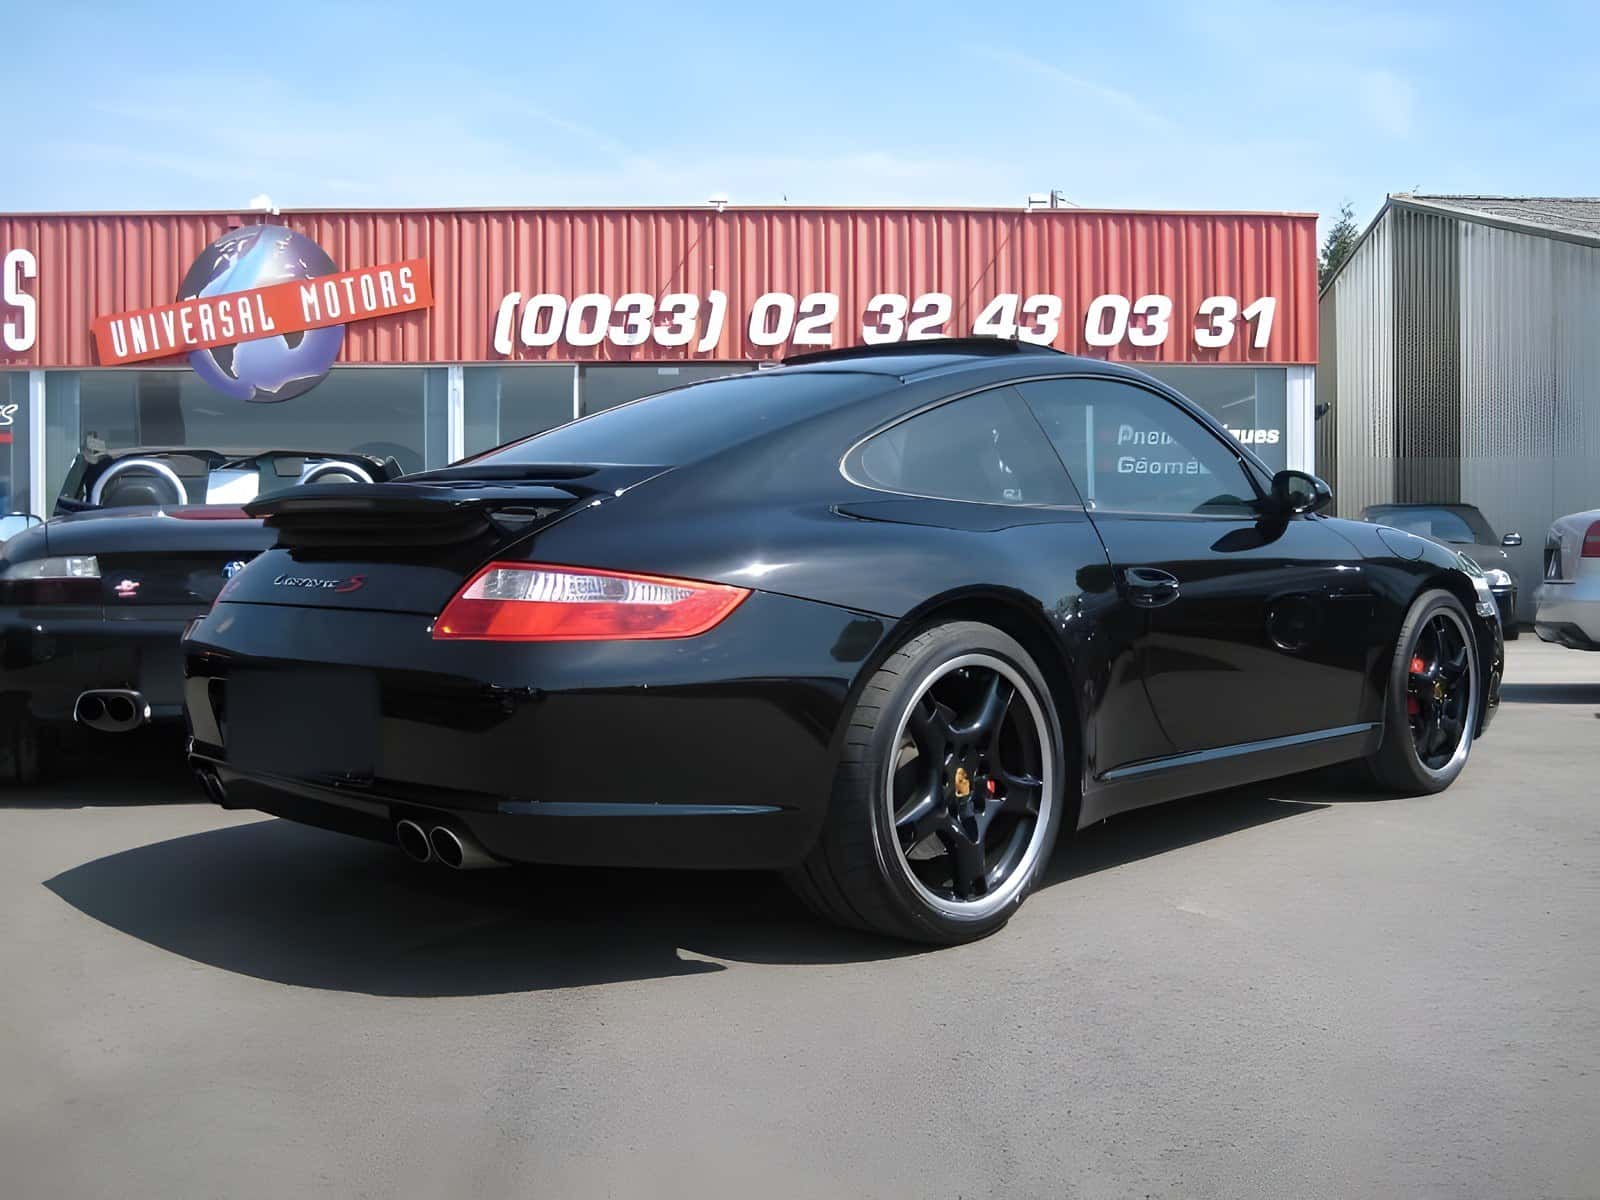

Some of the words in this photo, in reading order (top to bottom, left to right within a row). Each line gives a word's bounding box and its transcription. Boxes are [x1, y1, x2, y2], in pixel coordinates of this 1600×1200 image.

[109, 294, 275, 357] UNIVERSAL
[299, 267, 417, 324] MOTORS
[493, 290, 727, 355] (0033)
[748, 292, 840, 347] 02
[861, 292, 953, 346] 32
[972, 293, 1062, 346] 43
[1084, 293, 1172, 347] 03
[1193, 296, 1277, 348] 31
